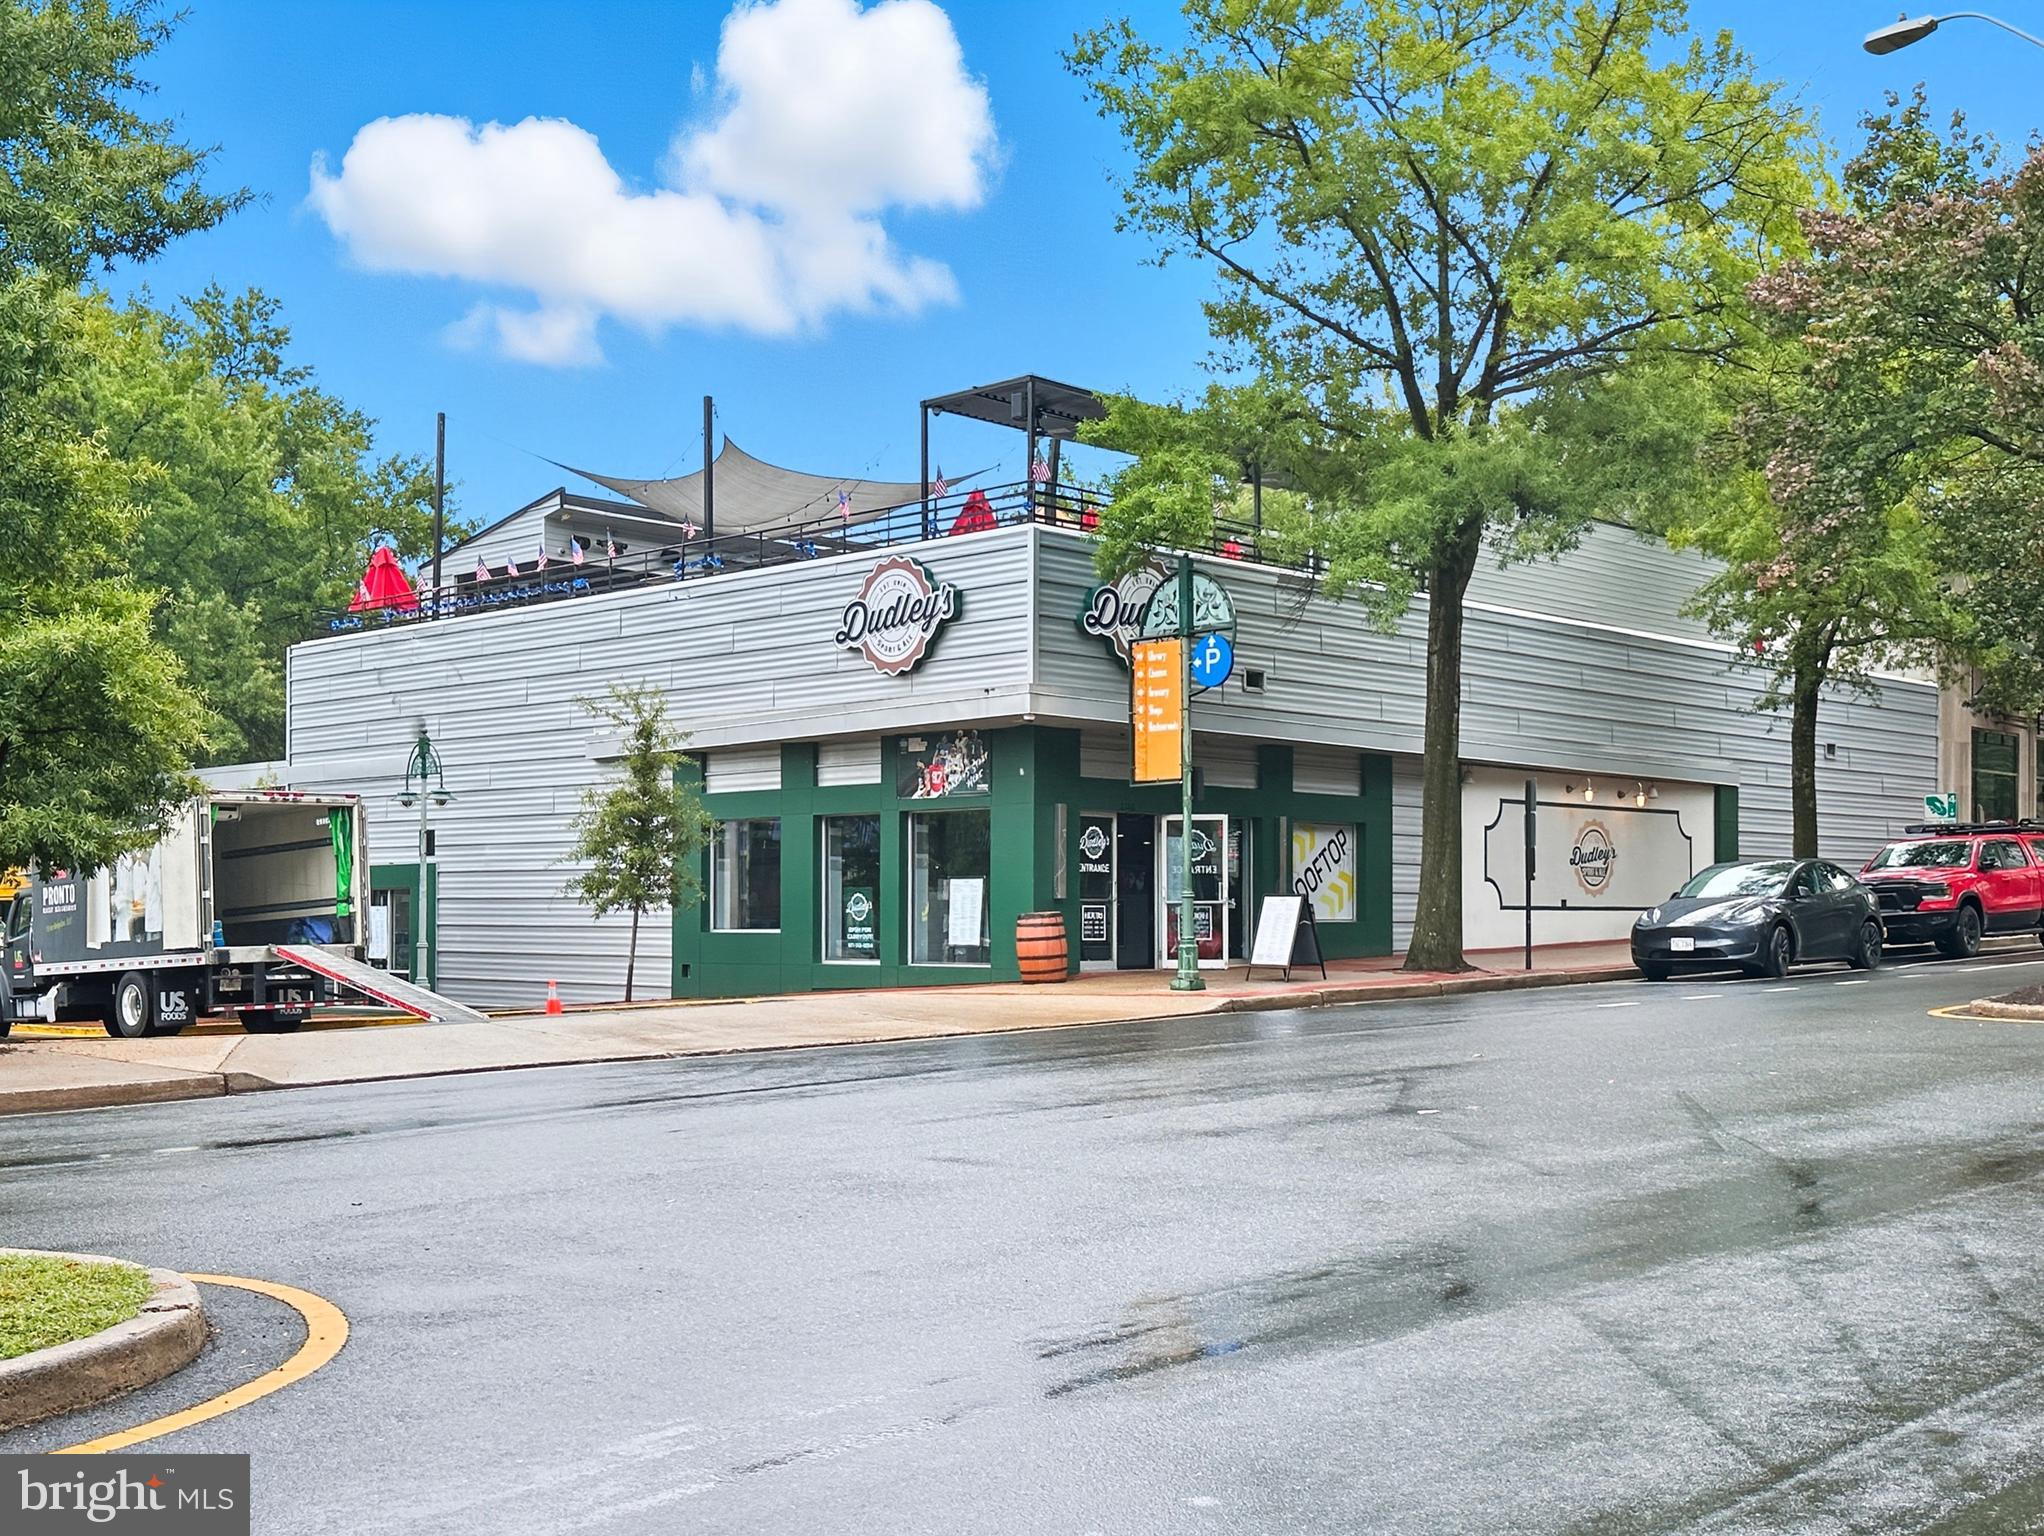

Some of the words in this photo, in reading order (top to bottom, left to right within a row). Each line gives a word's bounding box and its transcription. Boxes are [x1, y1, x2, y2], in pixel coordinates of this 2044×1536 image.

[835, 582, 952, 644] Dudley's
[1206, 648, 1221, 674] P
[1294, 829, 1347, 907] OOFTOP
[1569, 845, 1617, 867] Dudley's
[43, 884, 76, 905] PRONTO
[160, 1011, 188, 1021] FOODS
